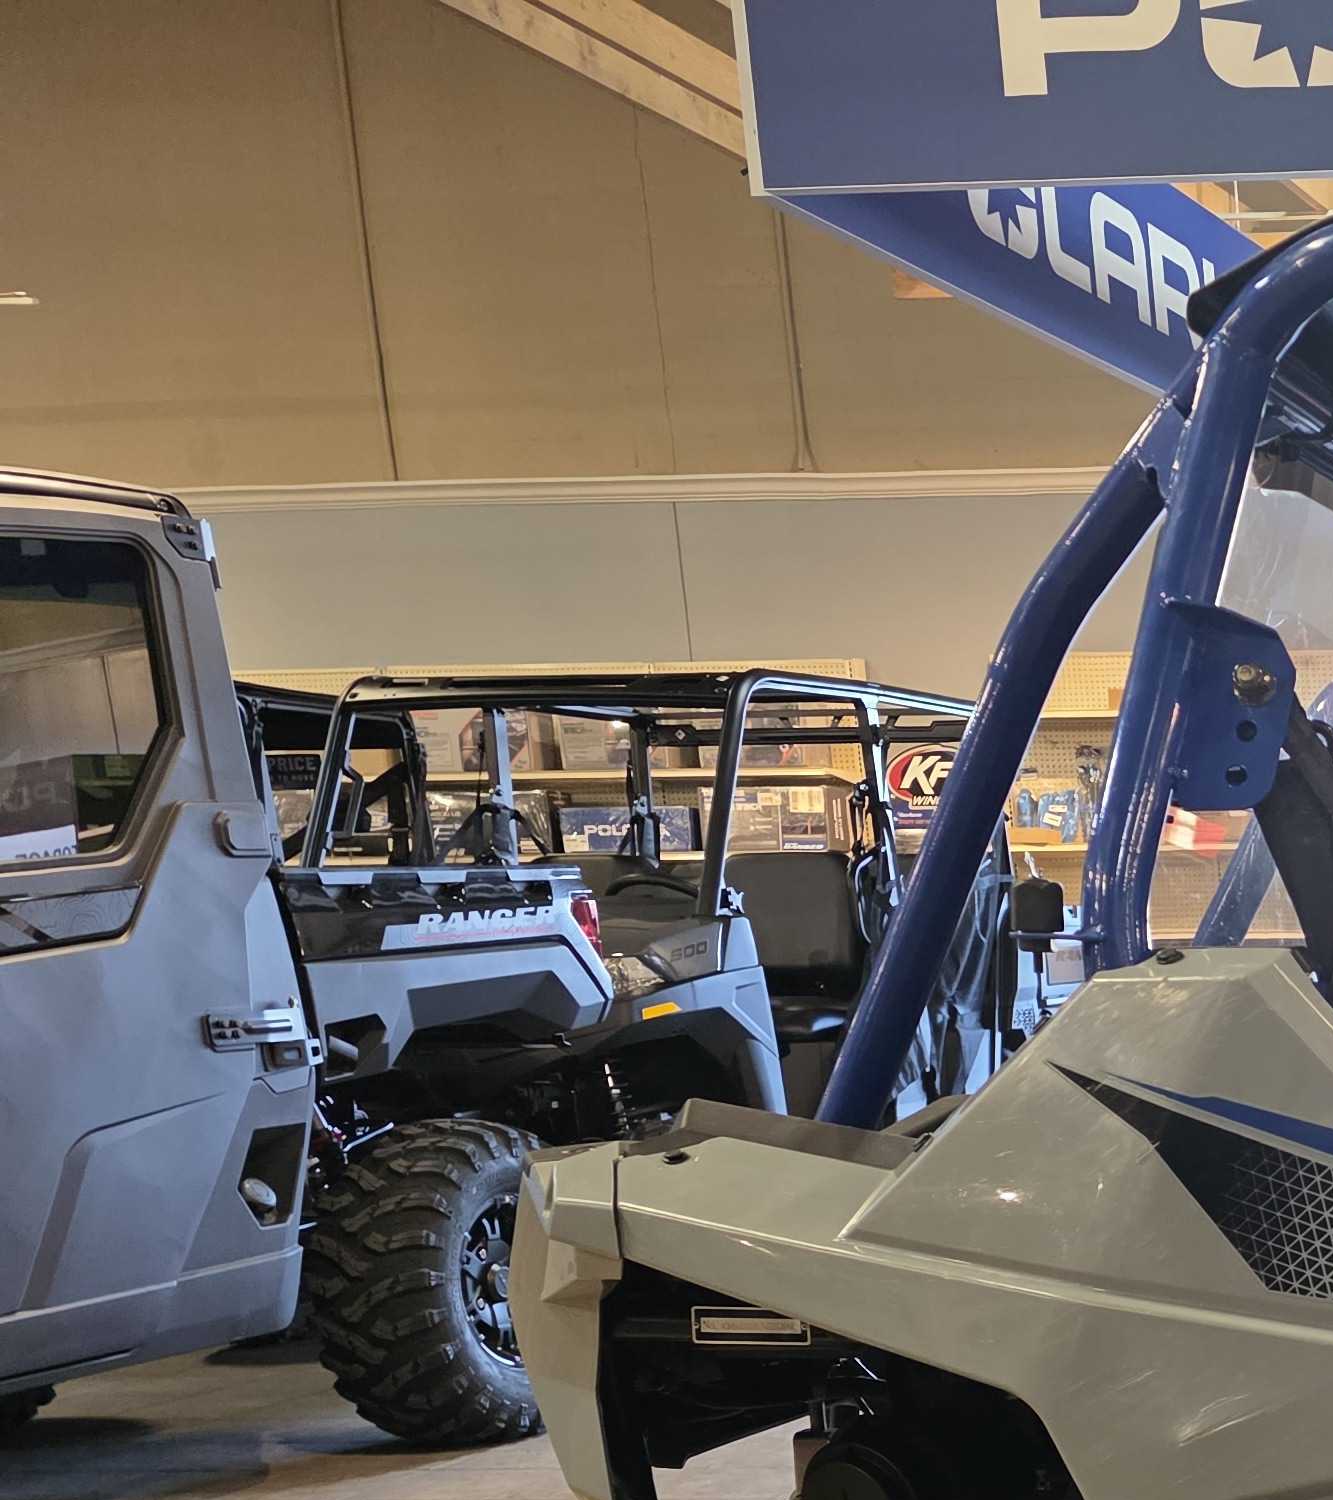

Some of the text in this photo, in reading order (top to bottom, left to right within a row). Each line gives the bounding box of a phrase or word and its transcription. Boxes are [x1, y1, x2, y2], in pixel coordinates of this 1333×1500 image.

[966, 186, 1216, 351] OLAR
[900, 756, 955, 795] KF
[912, 796, 941, 807] WIN
[416, 905, 551, 935] RANGER
